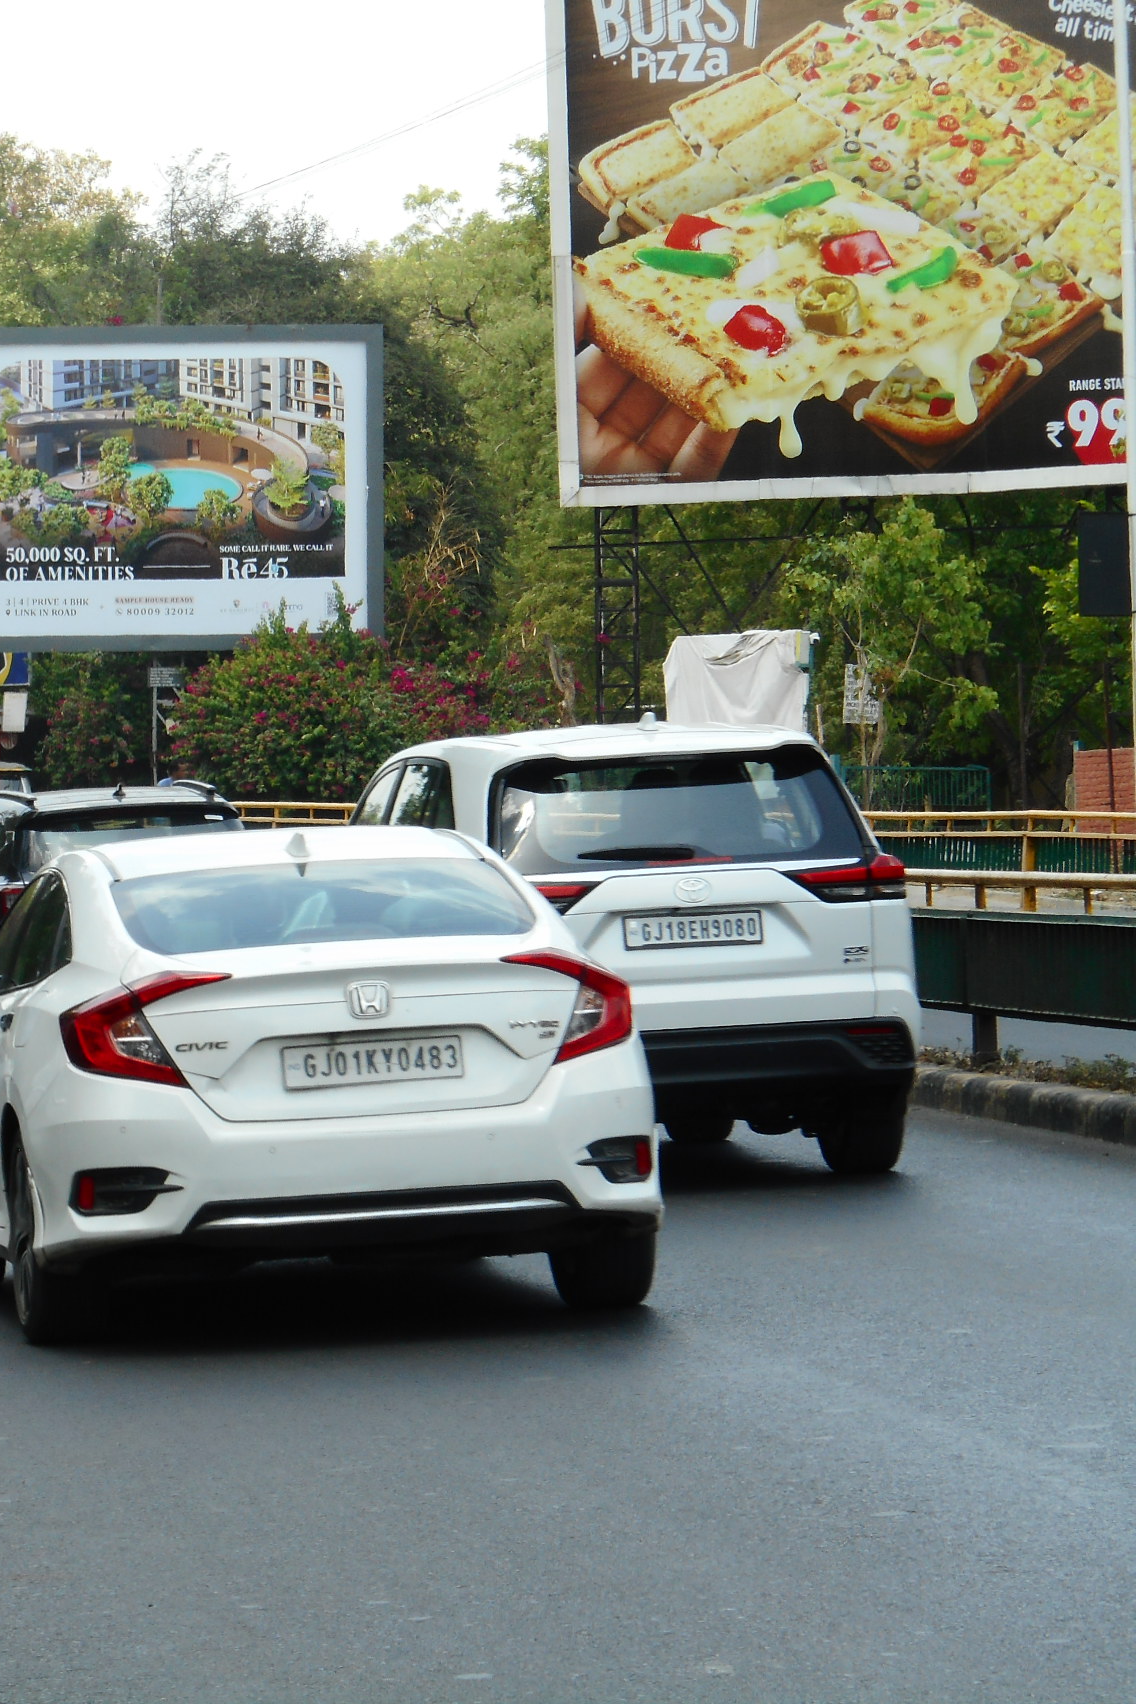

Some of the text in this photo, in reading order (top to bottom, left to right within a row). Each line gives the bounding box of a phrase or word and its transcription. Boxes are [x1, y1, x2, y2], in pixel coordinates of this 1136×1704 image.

[1055, 17, 1115, 41] all tim
[1069, 379, 1102, 391] RANGE
[5, 546, 120, 564] 50,000 SQ. FT.
[219, 545, 240, 553] SOME
[242, 545, 260, 553] CALL
[293, 544, 305, 552] WE
[5, 566, 135, 581] OF AMENITIES
[70, 598, 89, 606] BHK
[641, 918, 757, 941] GJ18EH9080
[175, 1041, 228, 1053] CIVIC
[303, 1045, 457, 1079] GJ01KY0483
